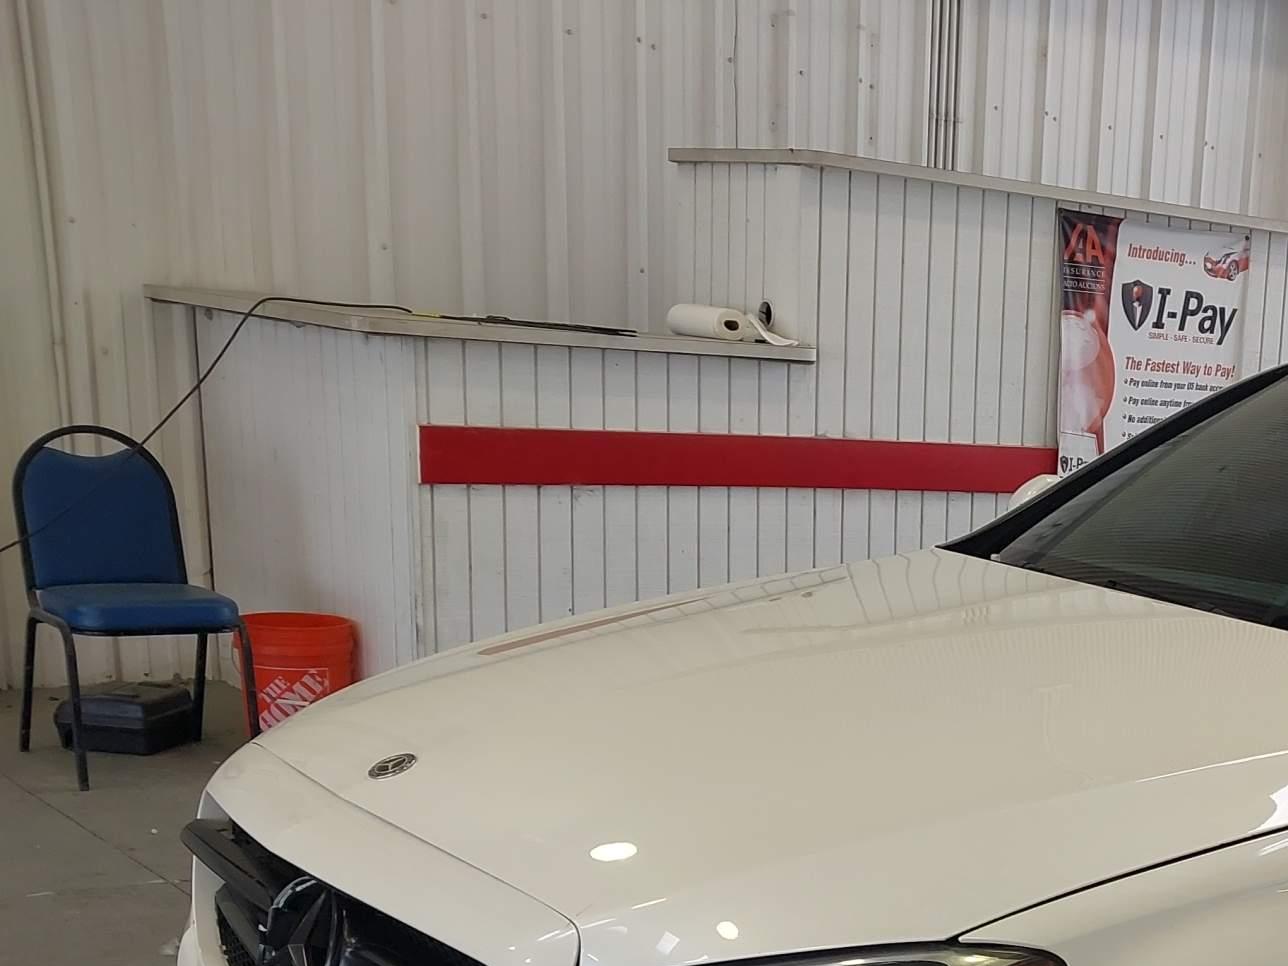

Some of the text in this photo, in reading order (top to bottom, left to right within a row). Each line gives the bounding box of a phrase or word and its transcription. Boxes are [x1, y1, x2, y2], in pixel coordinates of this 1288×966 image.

[1128, 243, 1196, 267] Introducing...
[1152, 287, 1238, 345] I-Pay
[1174, 334, 1188, 343] SAFE
[1125, 356, 1236, 380] The Fastest Way to Pay!
[1129, 378, 1140, 387] Pay
[1141, 379, 1158, 387] online
[1160, 380, 1172, 388] from
[1174, 382, 1186, 391] your
[1128, 396, 1140, 406] Pay
[1141, 398, 1158, 406] online
[1159, 399, 1182, 409] anytime
[1127, 414, 1136, 423] No
[1069, 457, 1089, 472] I-P
[259, 675, 291, 703] THE
